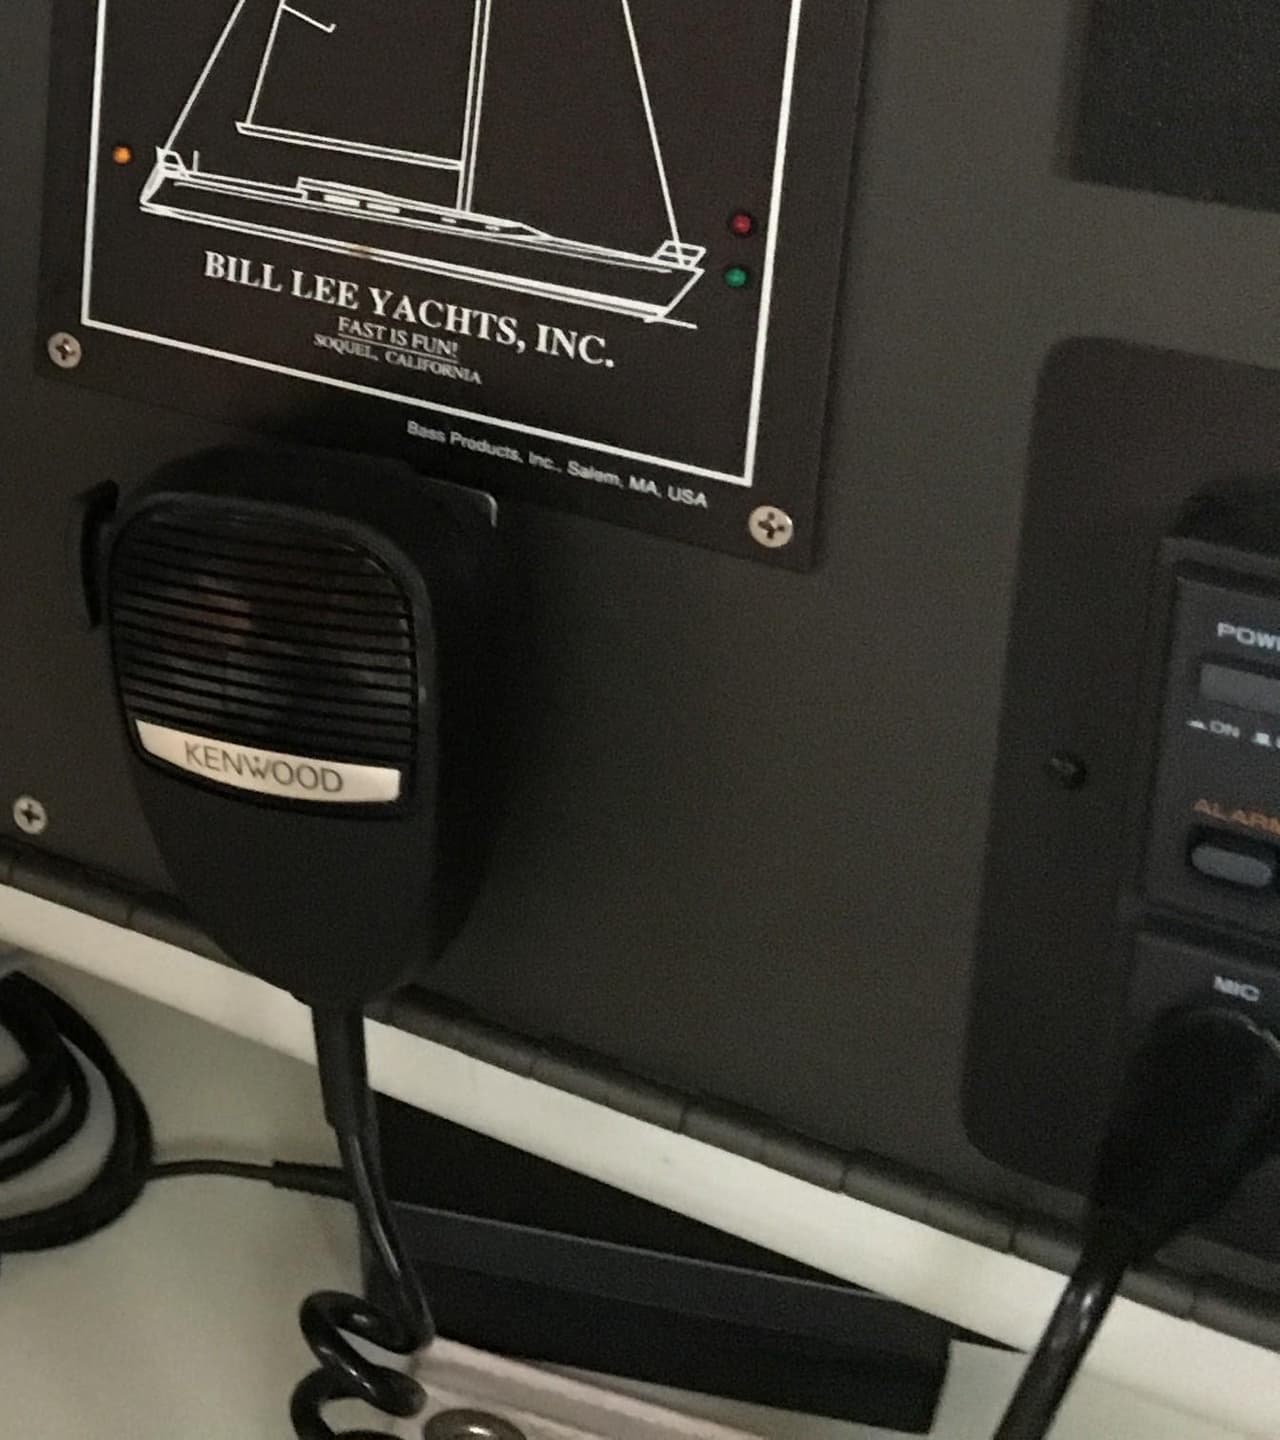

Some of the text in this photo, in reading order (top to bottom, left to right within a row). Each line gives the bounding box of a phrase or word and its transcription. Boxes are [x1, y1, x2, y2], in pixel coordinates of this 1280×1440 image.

[203, 250, 615, 368] BILL LEE YACHTS, INC.
[337, 316, 459, 358] FAST IS FUN!
[384, 349, 483, 385] CALIFORNIA
[667, 485, 708, 508] USA
[1216, 621, 1280, 651] POW
[183, 739, 345, 794] KENWOOD
[1213, 975, 1260, 1002] MIC
